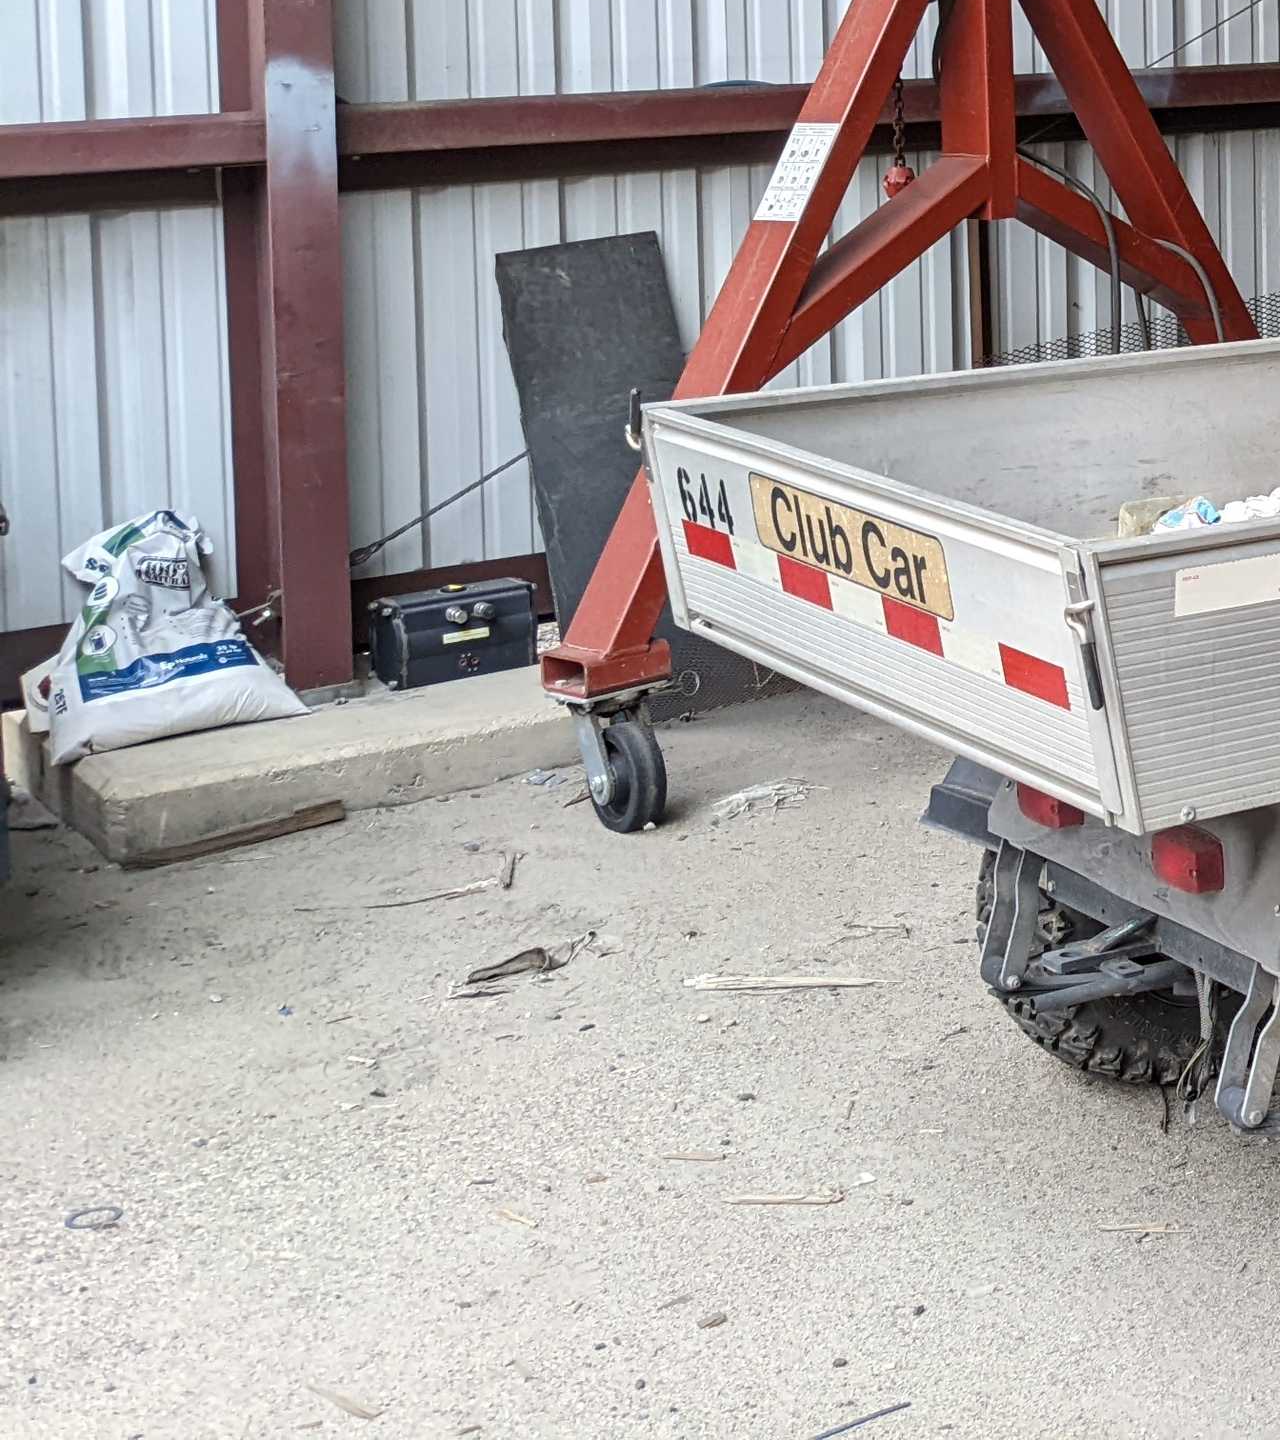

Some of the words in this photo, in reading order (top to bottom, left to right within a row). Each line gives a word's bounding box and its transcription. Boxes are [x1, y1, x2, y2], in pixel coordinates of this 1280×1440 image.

[677, 466, 735, 536] 644
[770, 486, 854, 574] Club
[861, 520, 928, 605] Car
